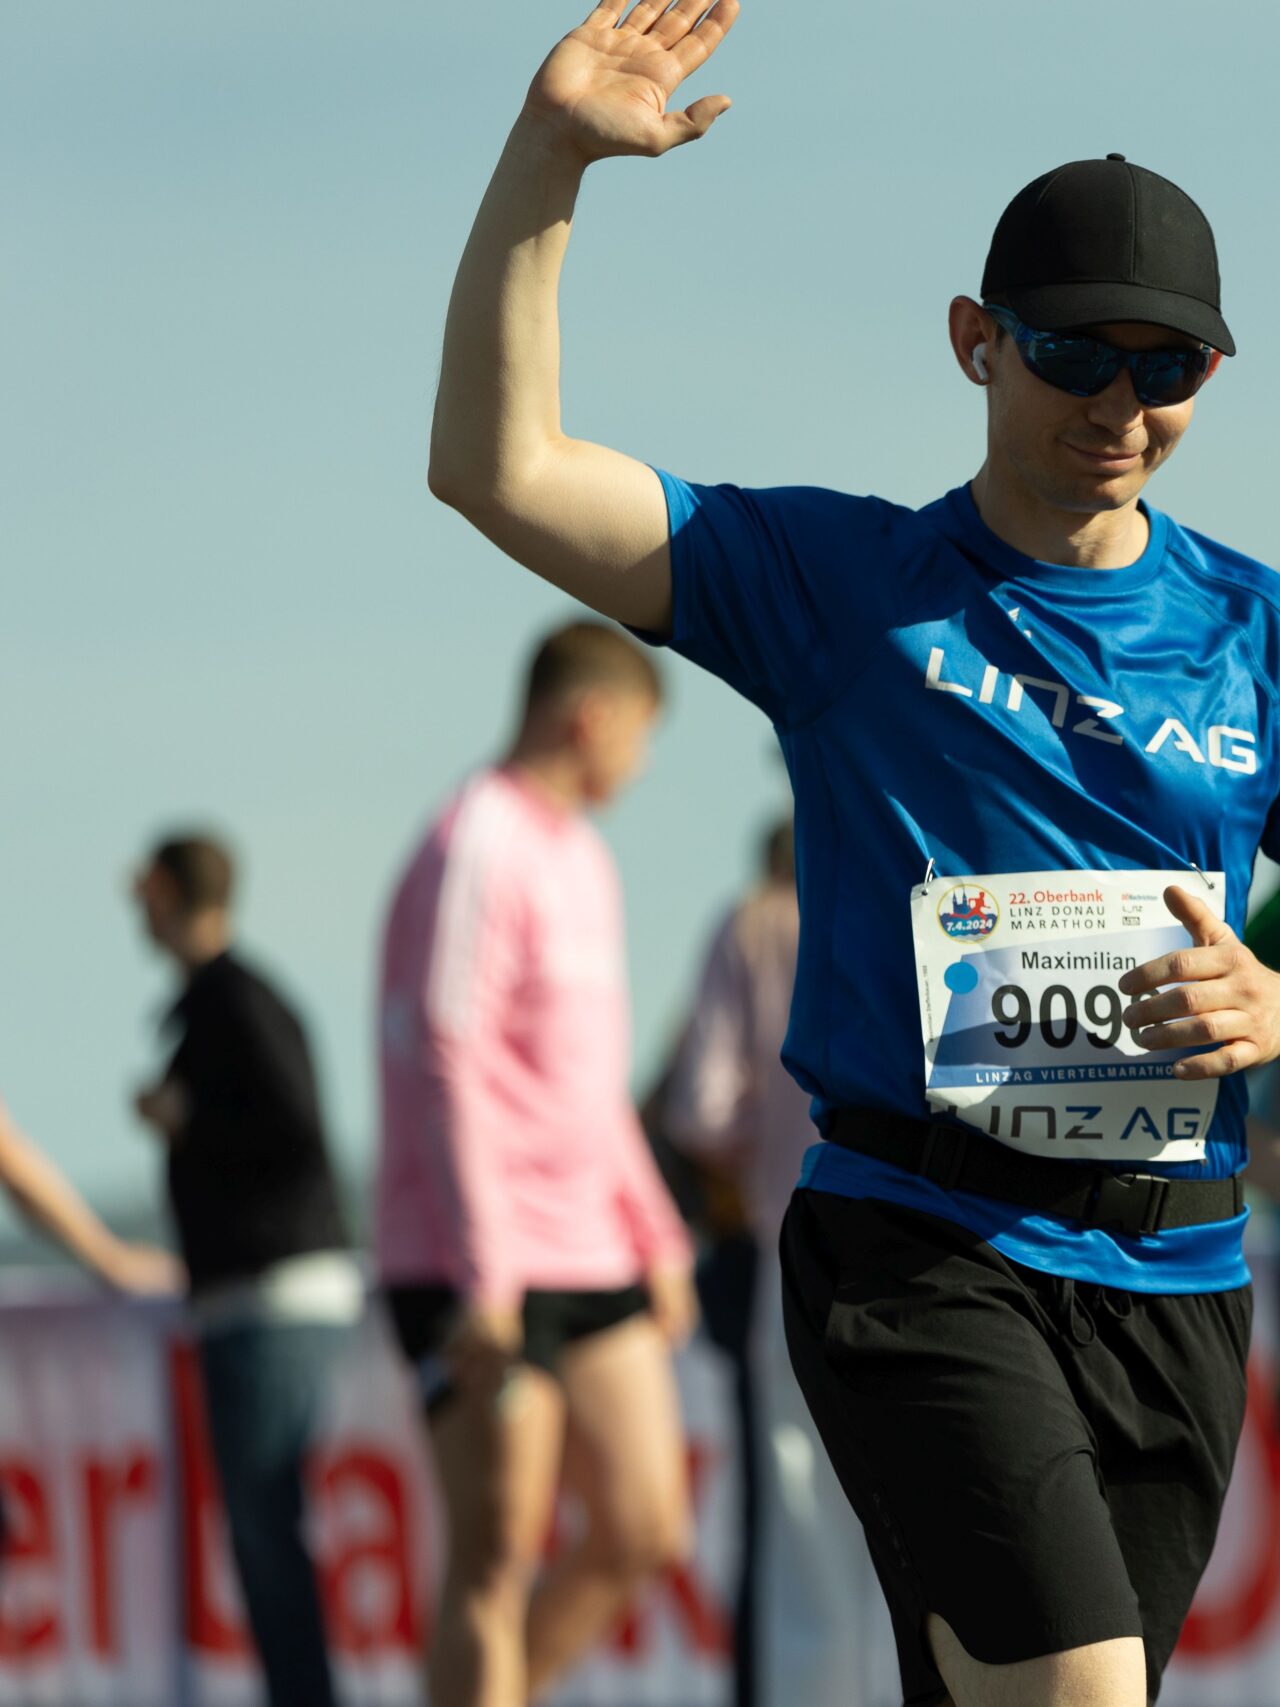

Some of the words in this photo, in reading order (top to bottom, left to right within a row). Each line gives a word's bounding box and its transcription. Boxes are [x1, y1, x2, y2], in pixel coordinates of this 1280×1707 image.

[925, 647, 1124, 744] LINZ
[1145, 718, 1257, 775] AG
[1009, 892, 1031, 905] 22.
[1034, 889, 1104, 902] Oberbank
[1010, 907, 1042, 917] LINZ
[1052, 905, 1105, 916] DONAU
[946, 918, 993, 931] 7.4.2024
[1011, 919, 1105, 930] MARATHON
[1021, 951, 1137, 970] Maximilian
[1041, 1065, 1174, 1081] VIERTELMARATHO
[948, 1105, 1103, 1140] INZ
[1119, 1106, 1202, 1140] AG
